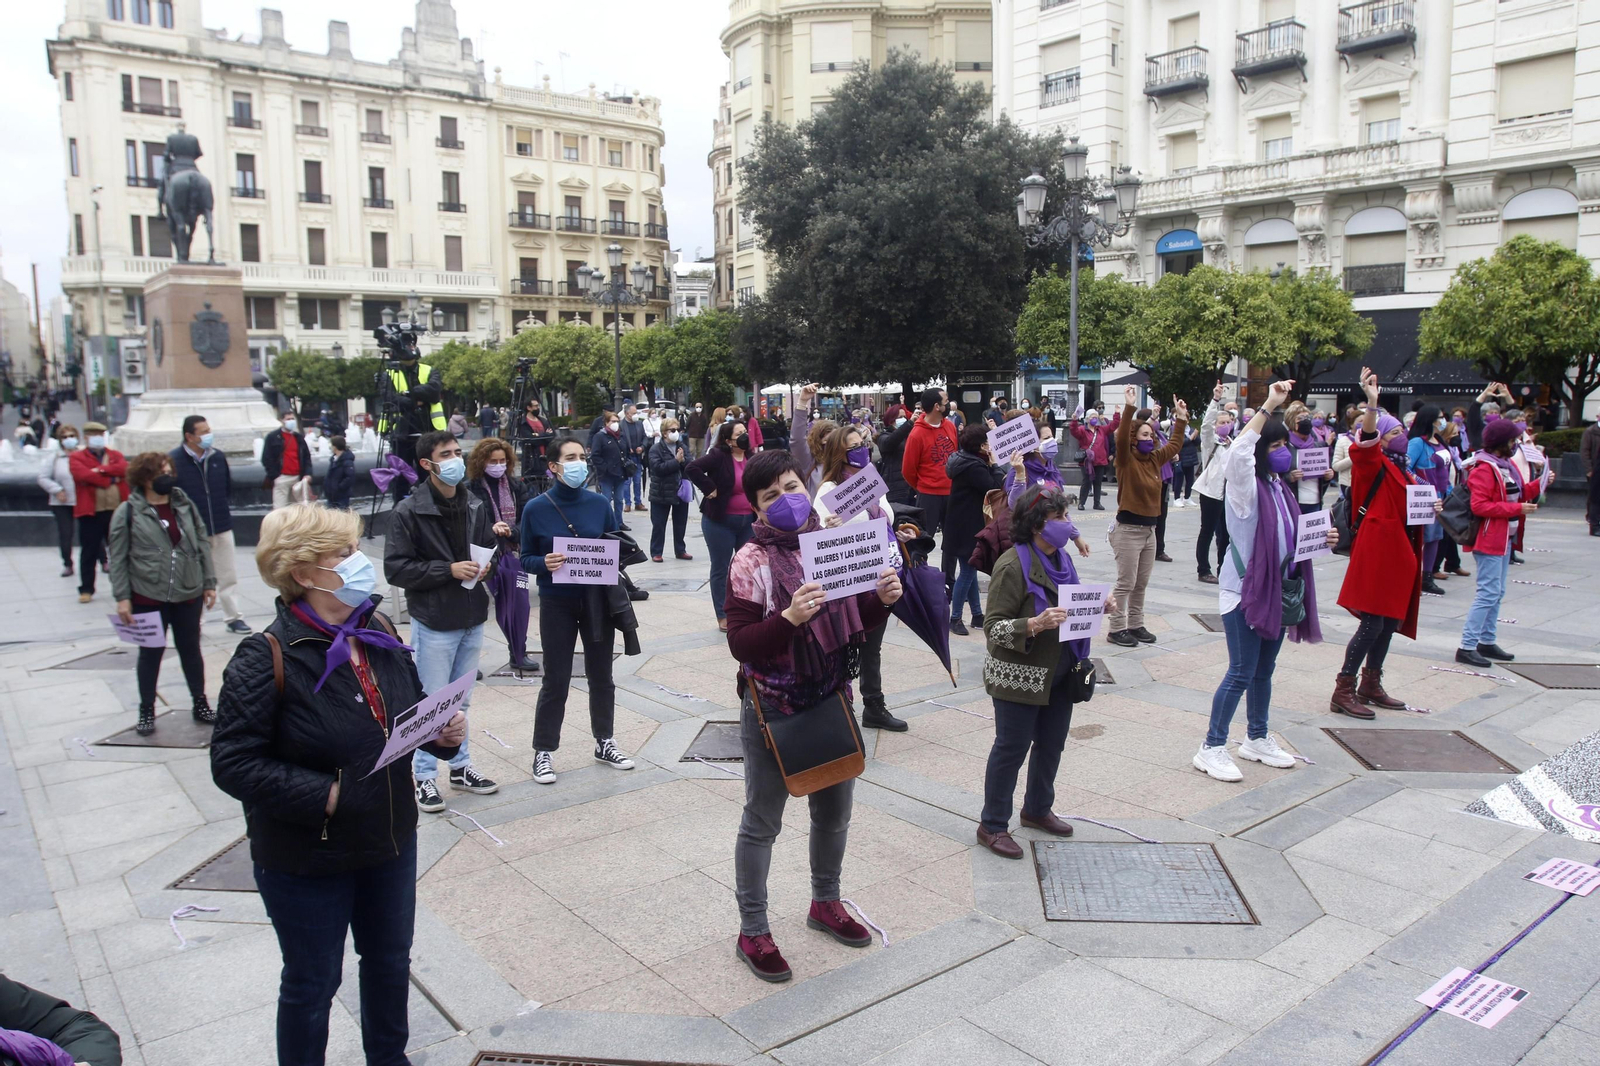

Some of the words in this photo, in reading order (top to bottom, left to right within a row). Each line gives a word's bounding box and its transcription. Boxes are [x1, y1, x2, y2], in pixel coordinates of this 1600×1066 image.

[1169, 240, 1194, 248] Sabadell
[995, 426, 1016, 439] DENUNCIAMOS
[998, 441, 1007, 449] CARGA
[1023, 438, 1036, 448] MUJERES
[834, 476, 866, 501] REIVINDICAMOS
[835, 500, 853, 515] REPARTO
[860, 480, 878, 495] TRABAJO
[861, 494, 875, 506] HOGAR
[817, 536, 854, 550] DENUNCIAMOS
[855, 533, 865, 542] QUE
[867, 531, 876, 539] LAS
[567, 544, 605, 553] REIVINDICAMOS
[814, 552, 839, 565] MUJERES
[845, 549, 854, 559] LAS
[855, 546, 870, 556] NIÑAS
[871, 544, 880, 552] SON
[812, 571, 823, 580] LAS
[824, 565, 847, 578] GRANDES
[848, 557, 883, 572] PERJUDICADAS
[822, 580, 845, 591] DURANTE
[854, 572, 878, 584] PANDEMIA
[452, 690, 464, 705] no
[439, 699, 450, 714] es
[400, 701, 440, 739] justicia.
